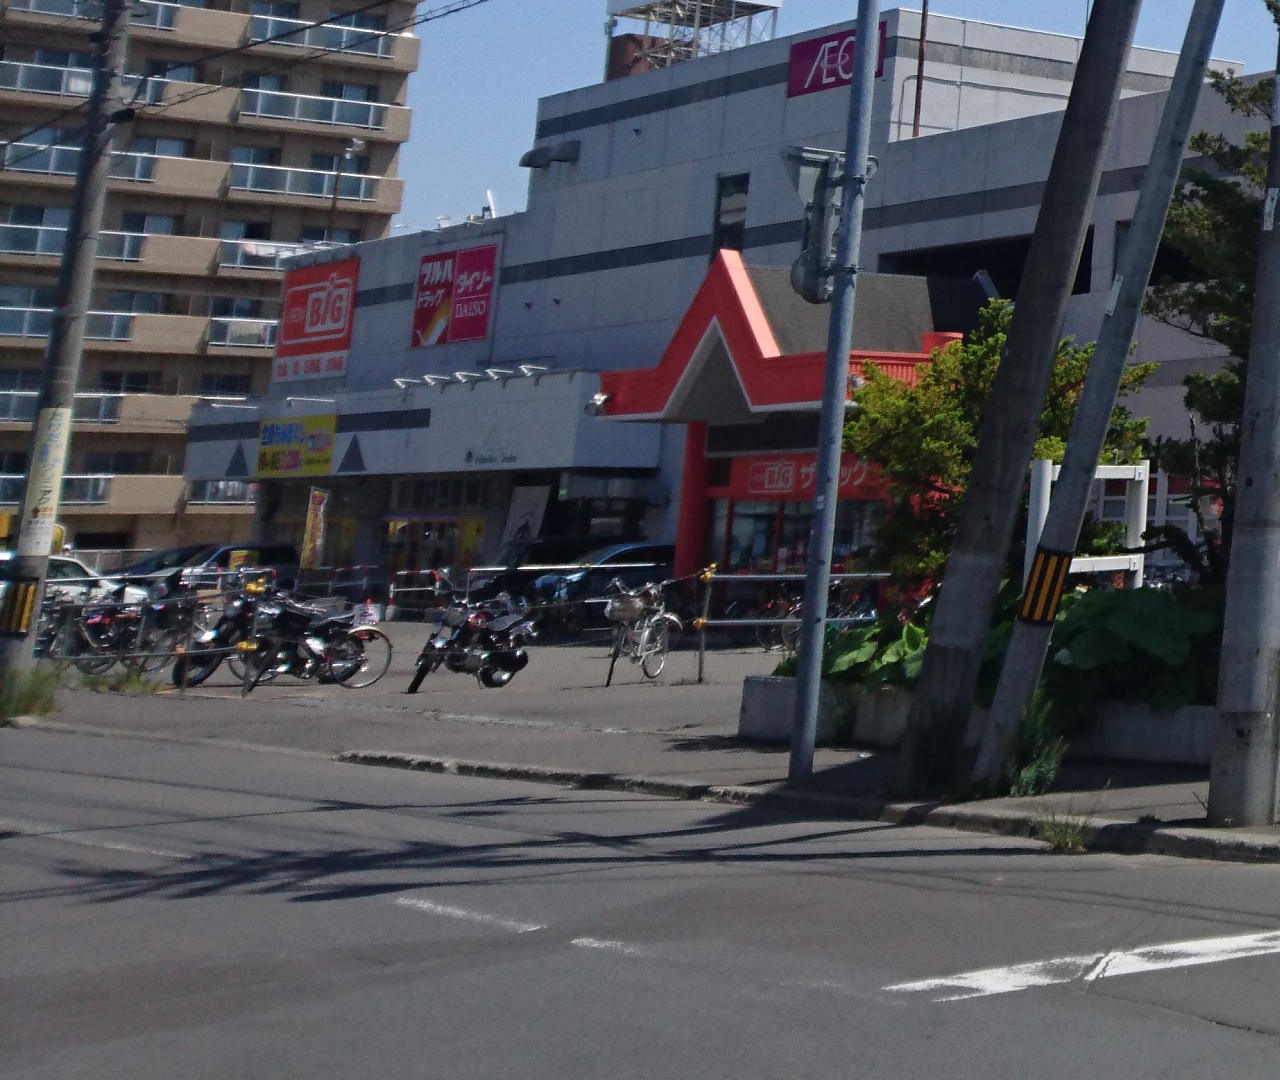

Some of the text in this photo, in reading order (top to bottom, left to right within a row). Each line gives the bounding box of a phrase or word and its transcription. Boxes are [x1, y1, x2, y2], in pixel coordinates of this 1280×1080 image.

[421, 258, 454, 286] ツルハ
[417, 288, 446, 309] ドラッグ
[454, 300, 487, 319] DAISO
